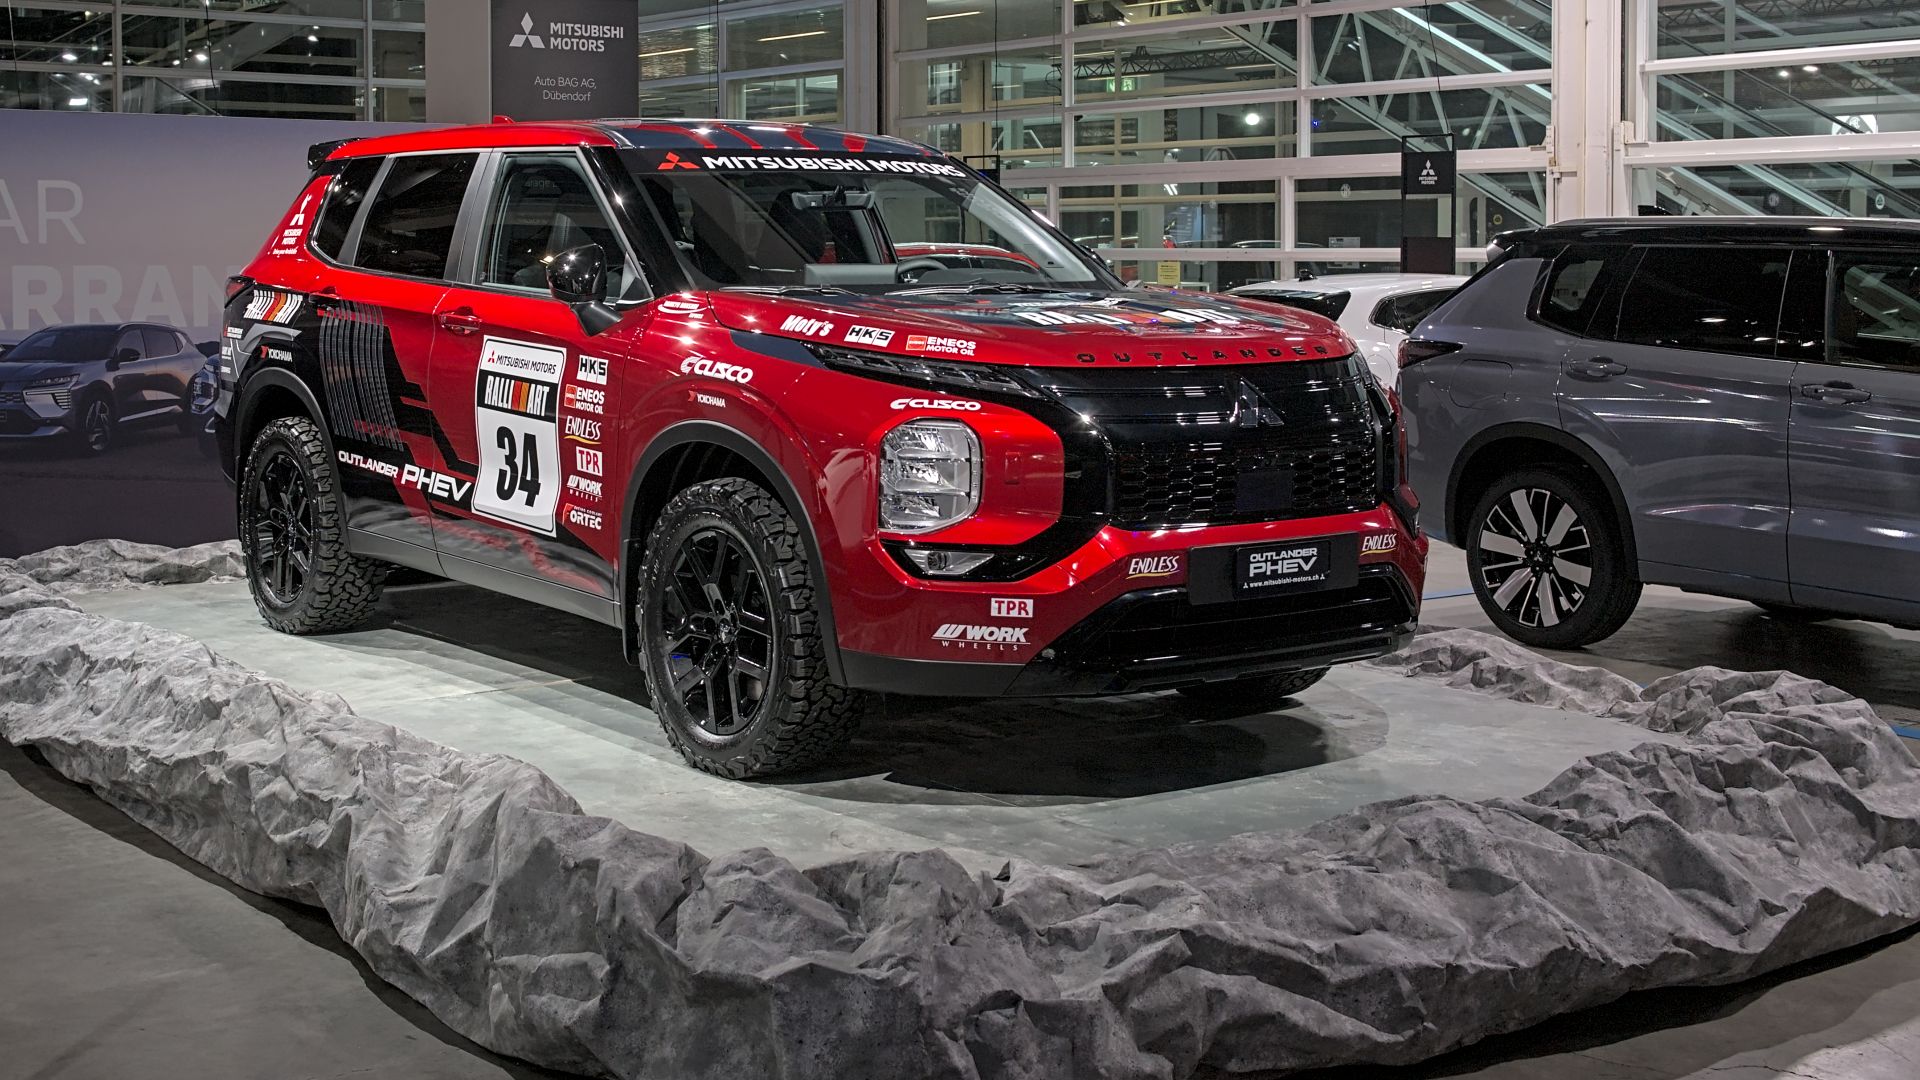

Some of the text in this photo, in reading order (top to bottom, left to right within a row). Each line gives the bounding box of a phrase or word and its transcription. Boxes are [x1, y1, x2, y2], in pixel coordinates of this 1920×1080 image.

[550, 22, 624, 39] MITSUBISHI
[550, 37, 605, 52] MOTORS
[534, 76, 597, 89] Auto BAG AG,
[543, 90, 591, 102] Dübendorf
[701, 156, 967, 178] MITSUBISHI MOTORS
[780, 314, 835, 337] Moty's
[848, 326, 892, 342] HKS
[926, 336, 977, 350] ENEOS
[926, 345, 975, 356] MOTOR OIL
[268, 348, 293, 363] YOKOHAMA
[1077, 346, 1329, 363] OUTLANDER
[495, 354, 557, 375] MITSUBISHI MOTORS
[579, 357, 608, 377] HKS
[576, 386, 605, 404] ENEOS
[696, 393, 726, 408] YOKOHAMA
[575, 401, 604, 415] MOTOR OIL
[565, 415, 602, 440] ENDLESS
[496, 426, 541, 507] 34
[579, 450, 600, 476] TPR
[338, 450, 473, 502] OUTLANDER PHEV
[578, 476, 602, 496] WORK
[1361, 533, 1397, 551] ENDLESS
[1249, 547, 1318, 562] OUTLANDER
[1128, 555, 1181, 575] ENDLESS
[1249, 557, 1318, 577] PHEV
[1249, 574, 1319, 588] www.mitsubishi-motors.ch
[994, 600, 1031, 616] TPR
[966, 625, 1030, 643] WORK
[942, 641, 1018, 651] WHEELS
